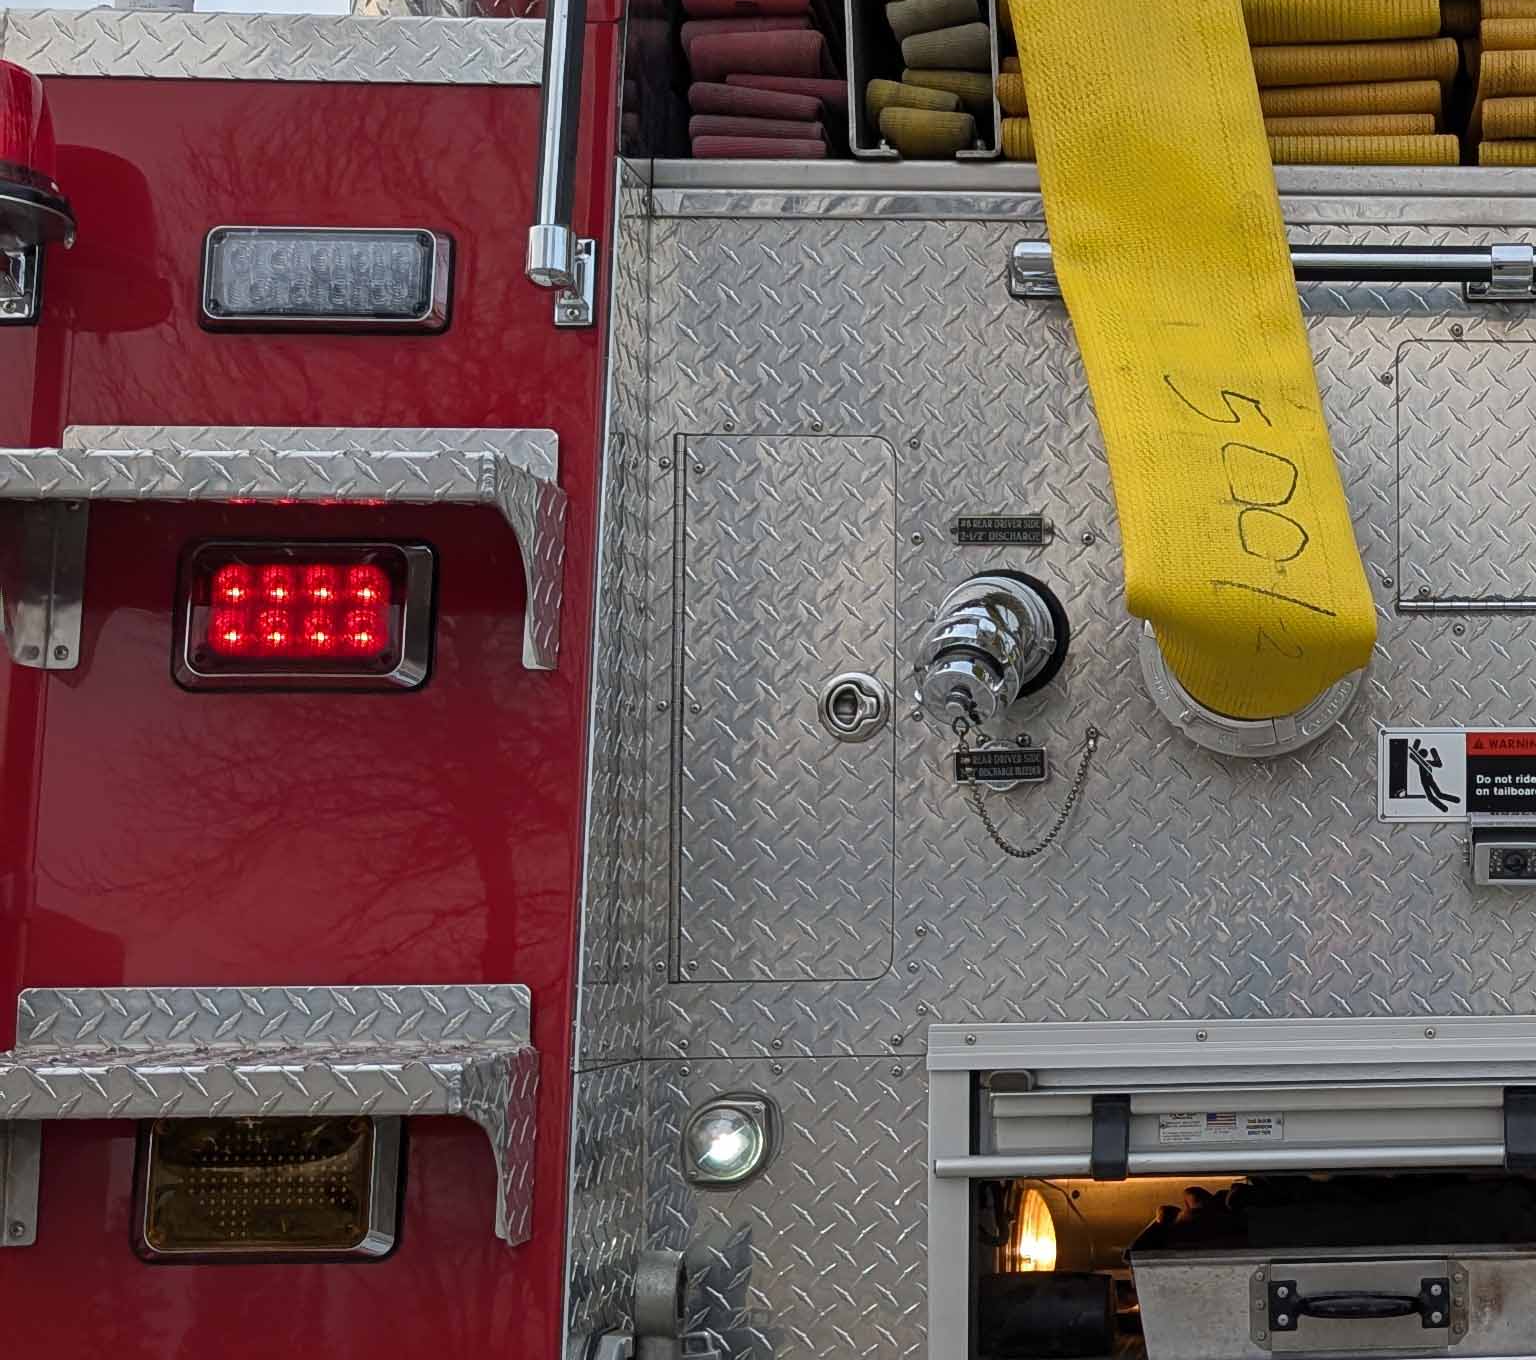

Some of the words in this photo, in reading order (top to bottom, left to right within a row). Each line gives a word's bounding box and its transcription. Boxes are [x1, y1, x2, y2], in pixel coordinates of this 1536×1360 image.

[973, 519, 993, 529] REAR
[994, 519, 1022, 529] DRIVER
[988, 531, 1041, 541] DISCHARGE
[1476, 774, 1491, 784] Do
[1494, 773, 1513, 784] not
[1515, 773, 1536, 784] ride
[1475, 786, 1490, 796] on
